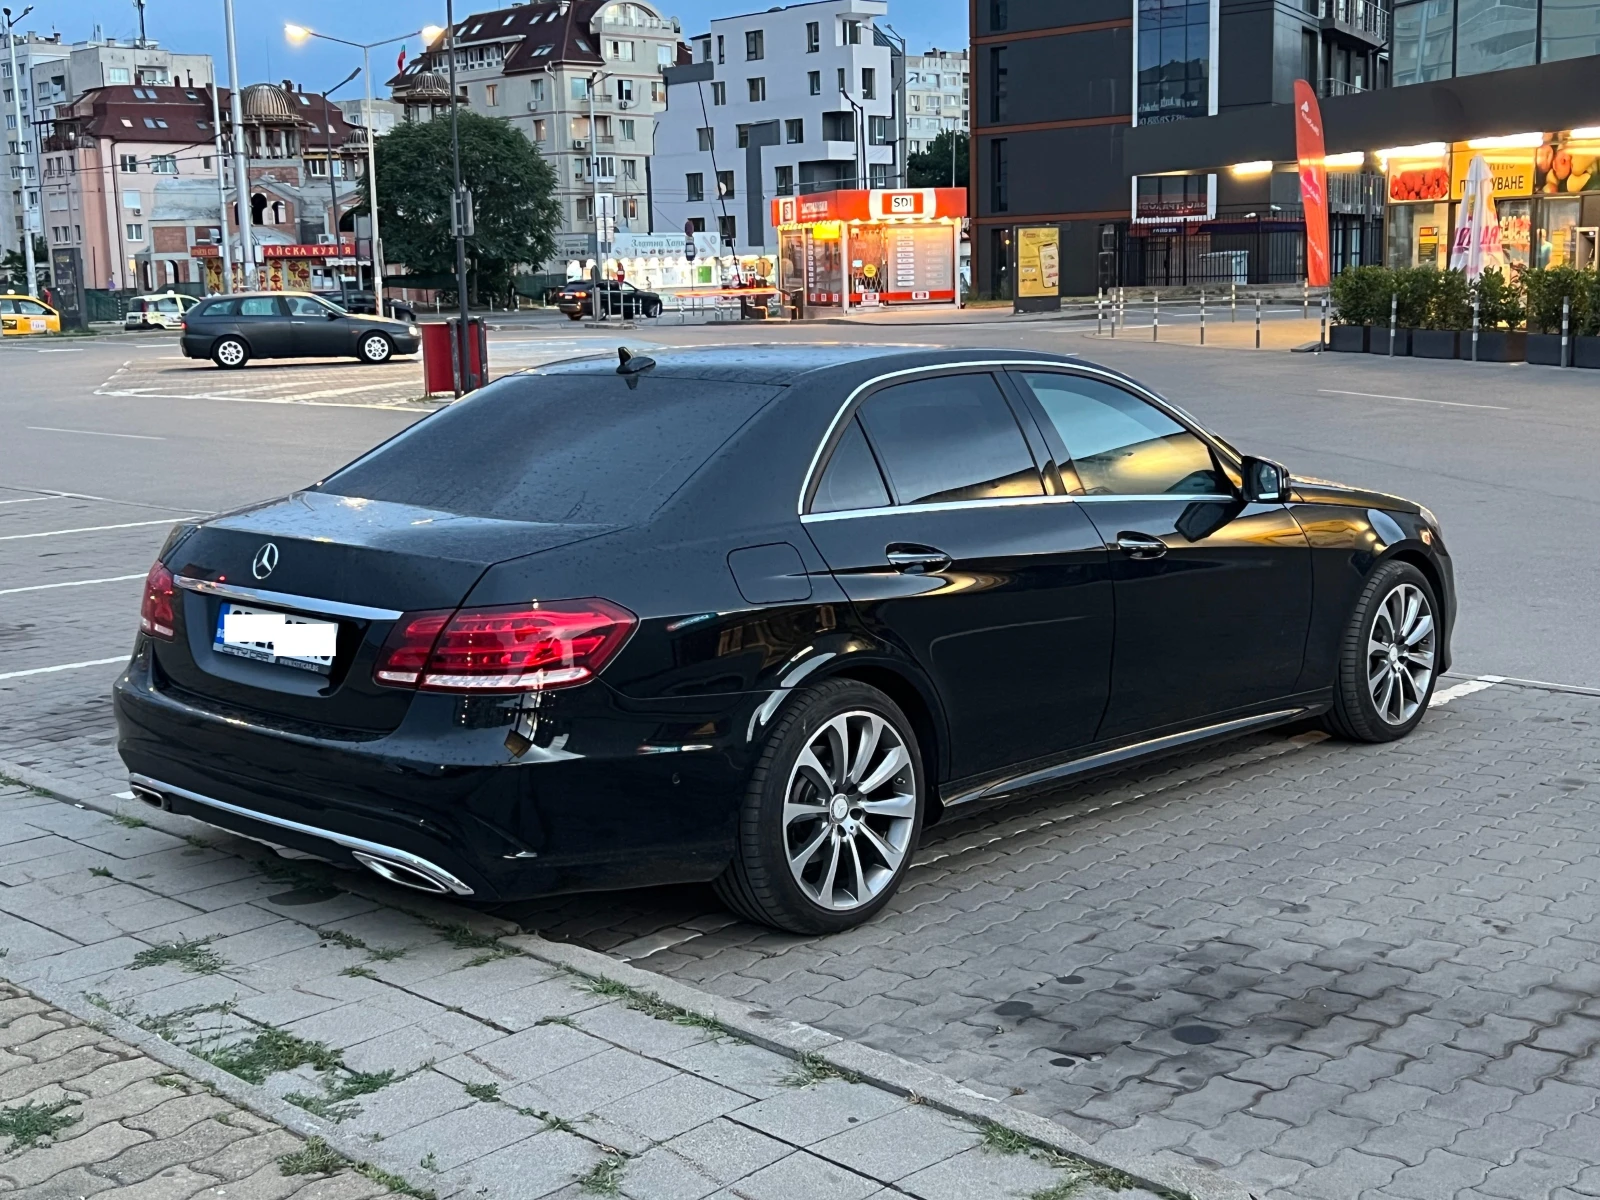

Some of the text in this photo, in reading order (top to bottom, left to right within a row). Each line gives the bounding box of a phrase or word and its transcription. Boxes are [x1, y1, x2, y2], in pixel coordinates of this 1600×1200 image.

[1459, 175, 1524, 193] ПУВАНЕ
[893, 197, 912, 207] SDI
[665, 238, 685, 247] Хапк
[263, 245, 306, 256] АЙСКА
